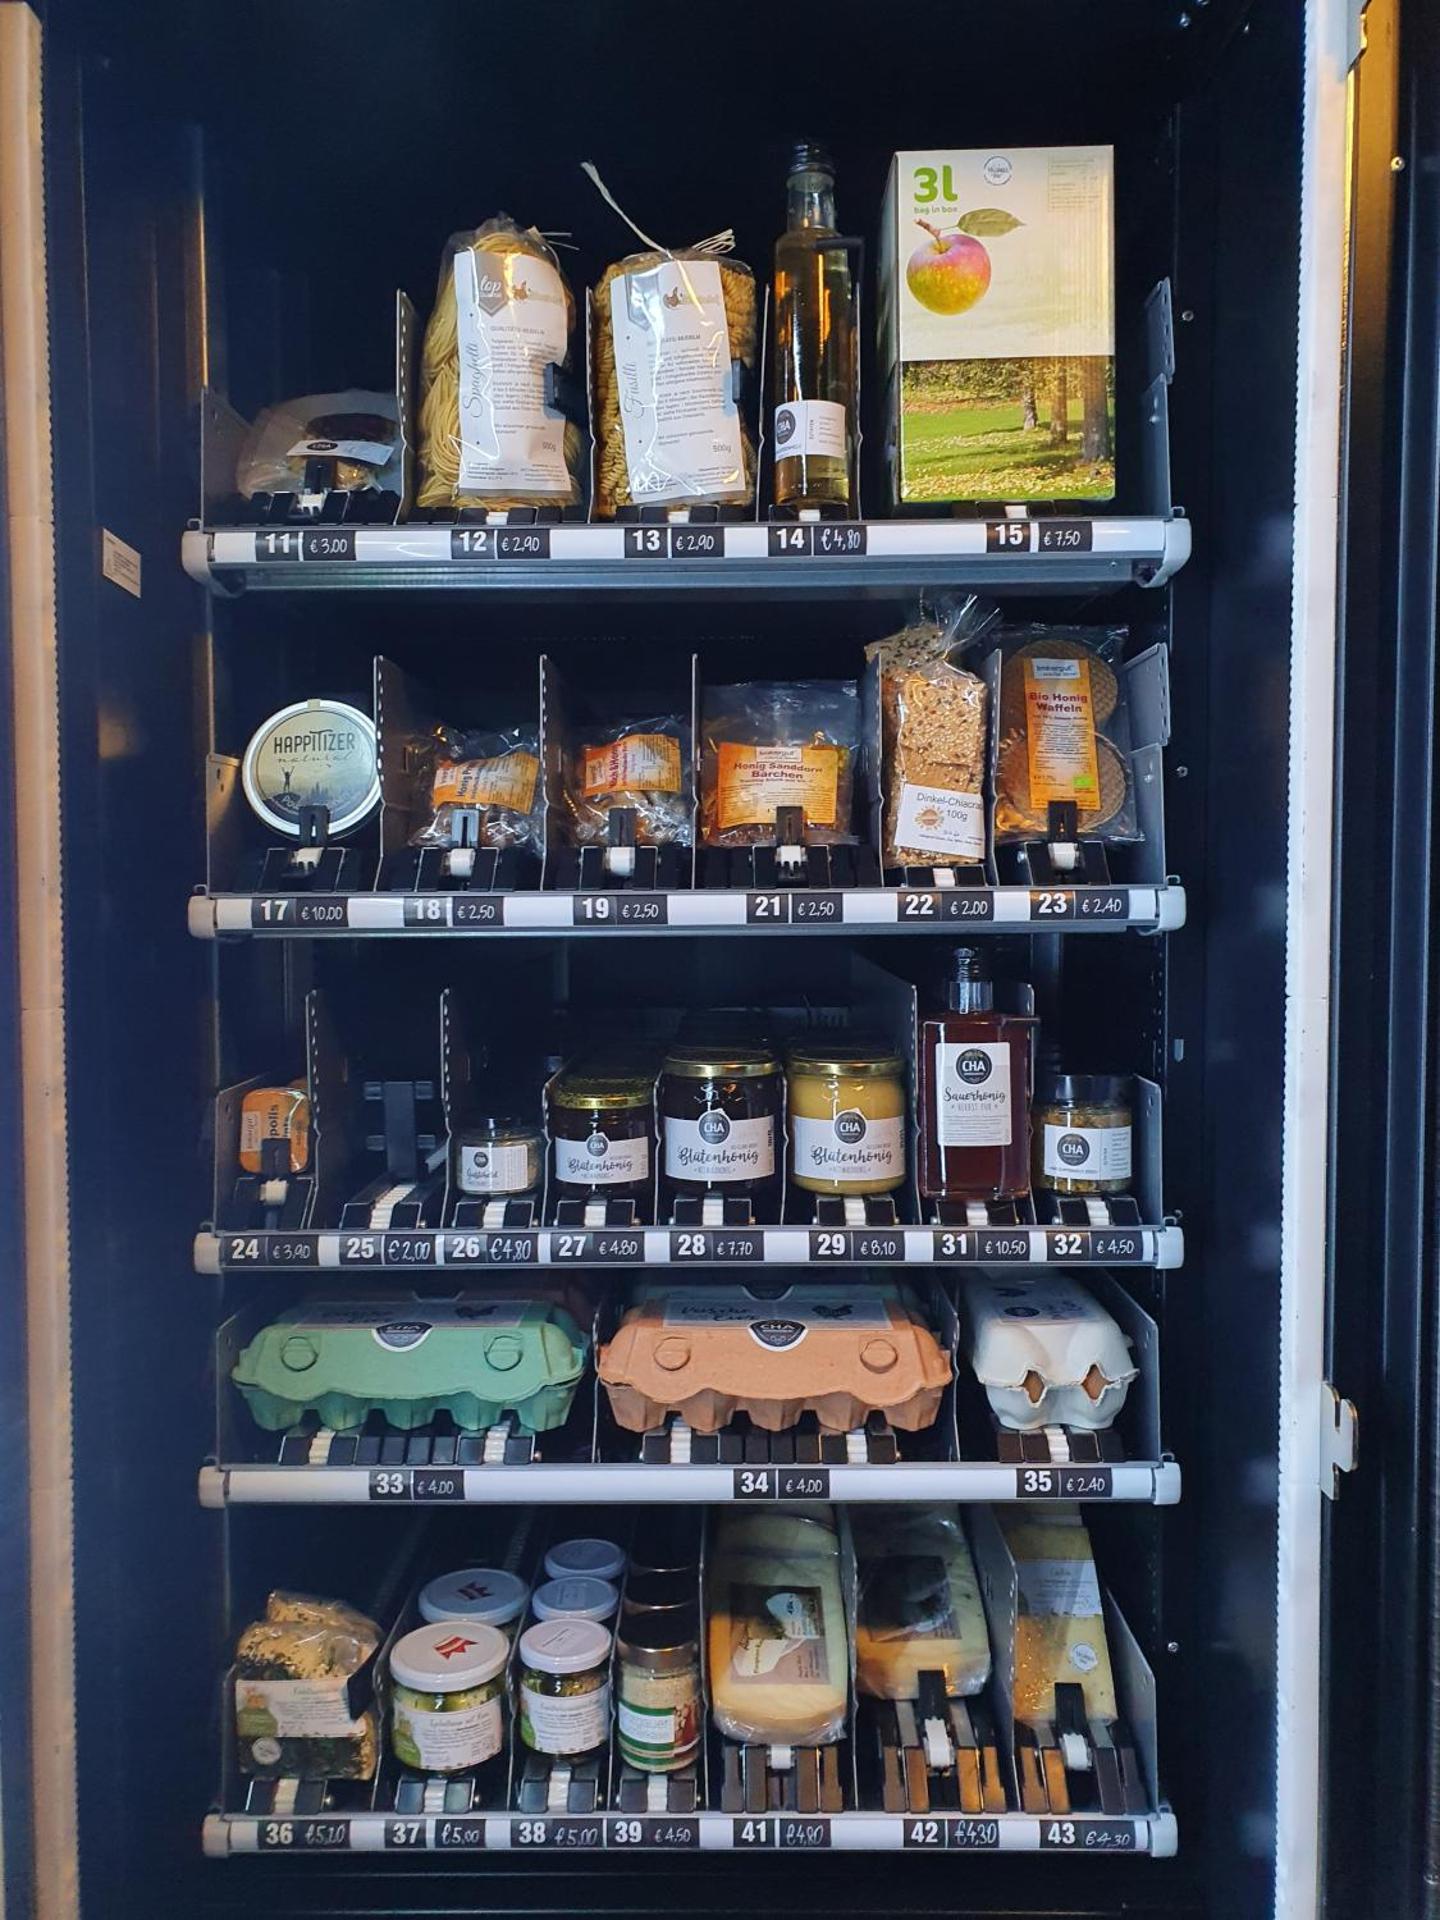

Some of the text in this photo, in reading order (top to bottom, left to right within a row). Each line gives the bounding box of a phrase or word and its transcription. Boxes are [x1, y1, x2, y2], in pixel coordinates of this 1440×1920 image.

[481, 274, 502, 293] top
[264, 532, 291, 554] 11
[459, 530, 488, 552] 12
[632, 529, 661, 551] 13
[776, 528, 805, 549] 14
[994, 524, 1024, 545] 15
[1029, 692, 1088, 704] Bio Honig
[1036, 702, 1083, 713] Waffeln
[273, 728, 355, 754] HAPPITIZER
[733, 762, 766, 771] Honig
[947, 809, 968, 822] 100g
[261, 901, 289, 921] 17
[413, 899, 441, 920] 18
[582, 898, 609, 918] 19
[755, 896, 781, 917] 21
[905, 894, 934, 915] 22
[1038, 893, 1067, 913] 23
[962, 1060, 986, 1072] CHA
[703, 1122, 725, 1132] CHA
[840, 1122, 861, 1132] CHA
[1062, 1143, 1084, 1155] CHA
[231, 1238, 260, 1259] 24
[347, 1237, 375, 1258] 25
[452, 1237, 480, 1258] 26
[558, 1235, 587, 1257] 27
[677, 1234, 706, 1255] 28
[817, 1234, 846, 1255] 29
[941, 1233, 967, 1255] 31
[1054, 1233, 1083, 1255] 32
[376, 1472, 404, 1494] 33
[740, 1471, 769, 1493] 34
[1024, 1470, 1052, 1492] 35
[265, 1822, 294, 1844] 36
[392, 1822, 421, 1844] 37
[518, 1822, 546, 1843] 38
[615, 1821, 642, 1843] 39
[741, 1821, 767, 1842] 41
[911, 1821, 939, 1843] 42
[1047, 1822, 1076, 1844] 43
